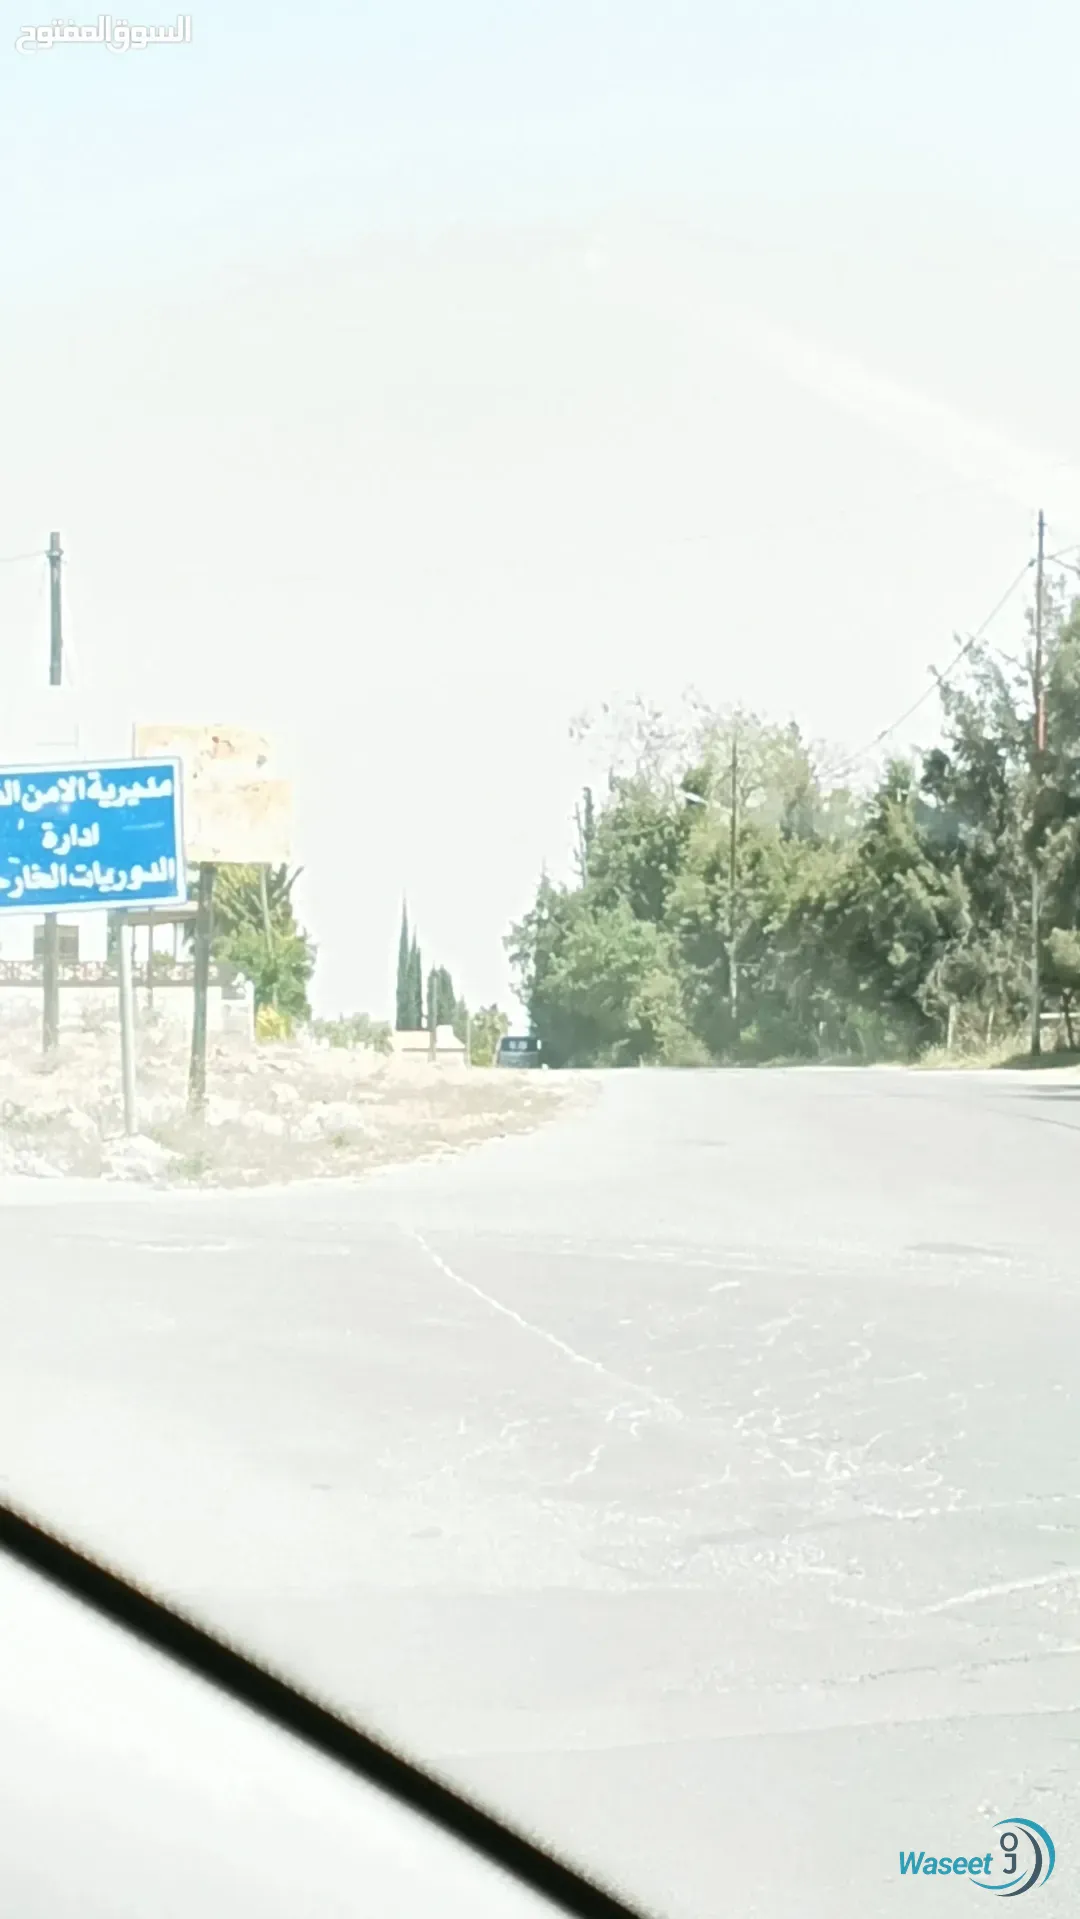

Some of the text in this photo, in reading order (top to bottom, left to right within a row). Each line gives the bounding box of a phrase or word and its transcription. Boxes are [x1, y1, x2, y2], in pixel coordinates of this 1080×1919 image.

[87, 771, 173, 808] مديرية
[41, 822, 100, 855] ادارة
[69, 856, 175, 892] الدوريات
